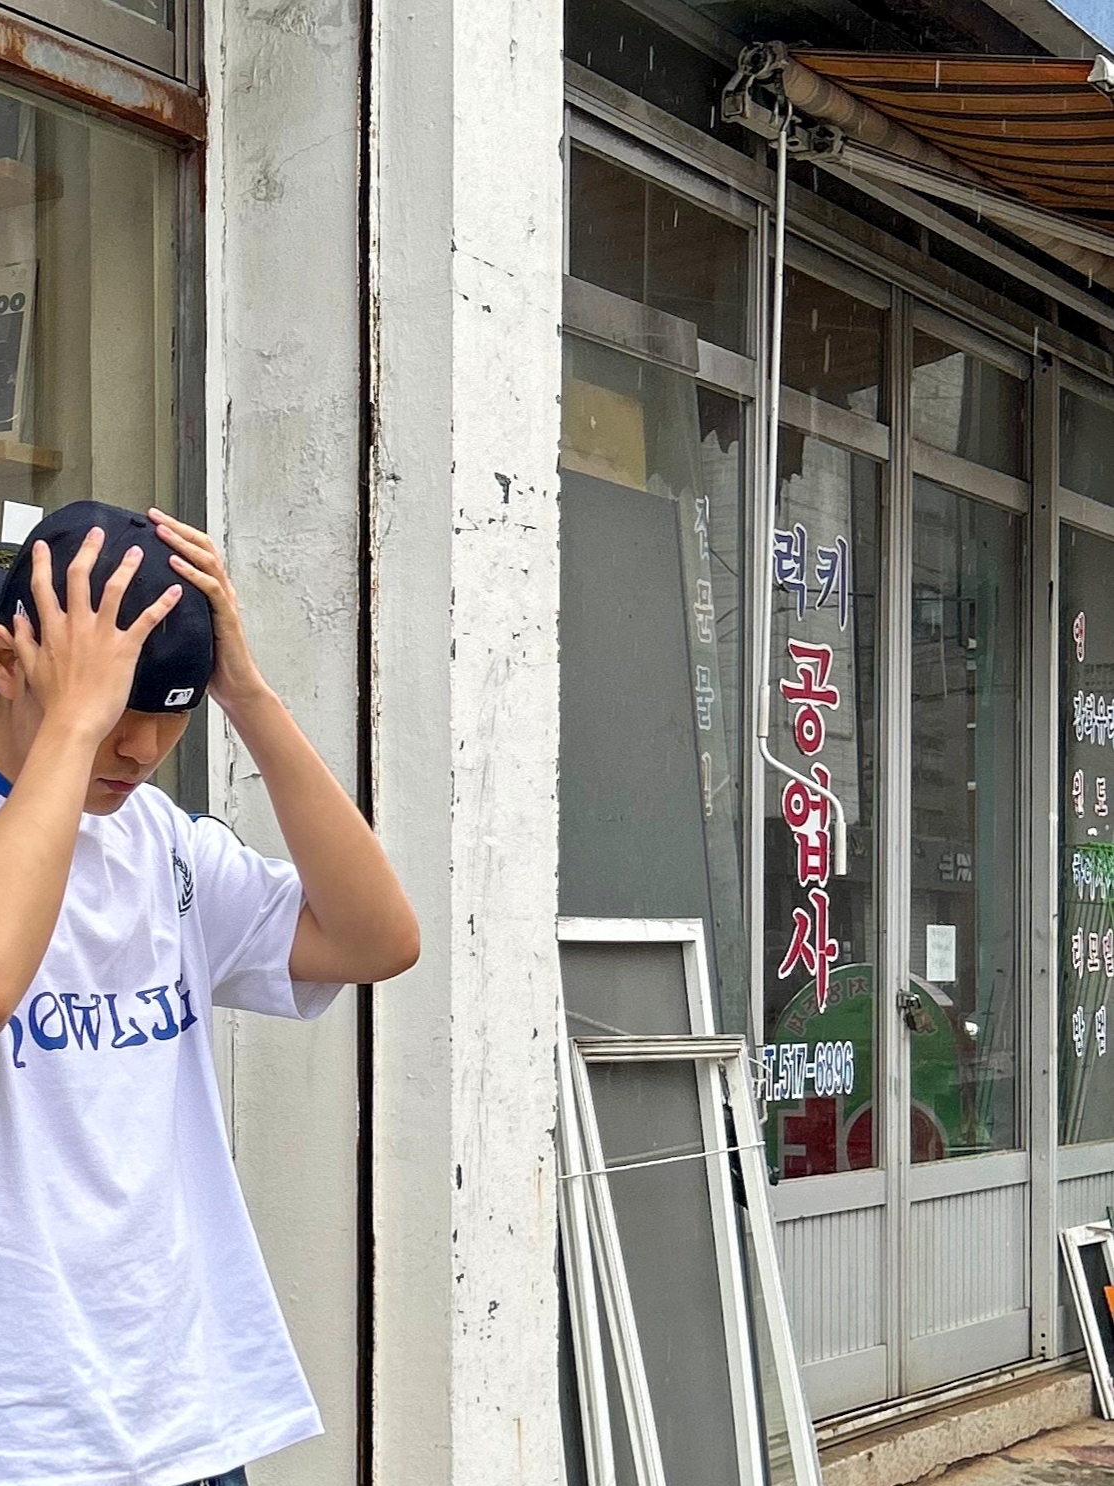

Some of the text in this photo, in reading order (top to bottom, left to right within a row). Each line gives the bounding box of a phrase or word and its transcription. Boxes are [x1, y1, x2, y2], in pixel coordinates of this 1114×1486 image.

[773, 522, 848, 632] 럭키
[777, 637, 840, 1015] 공업사
[762, 1040, 855, 1102] T.517-6896
